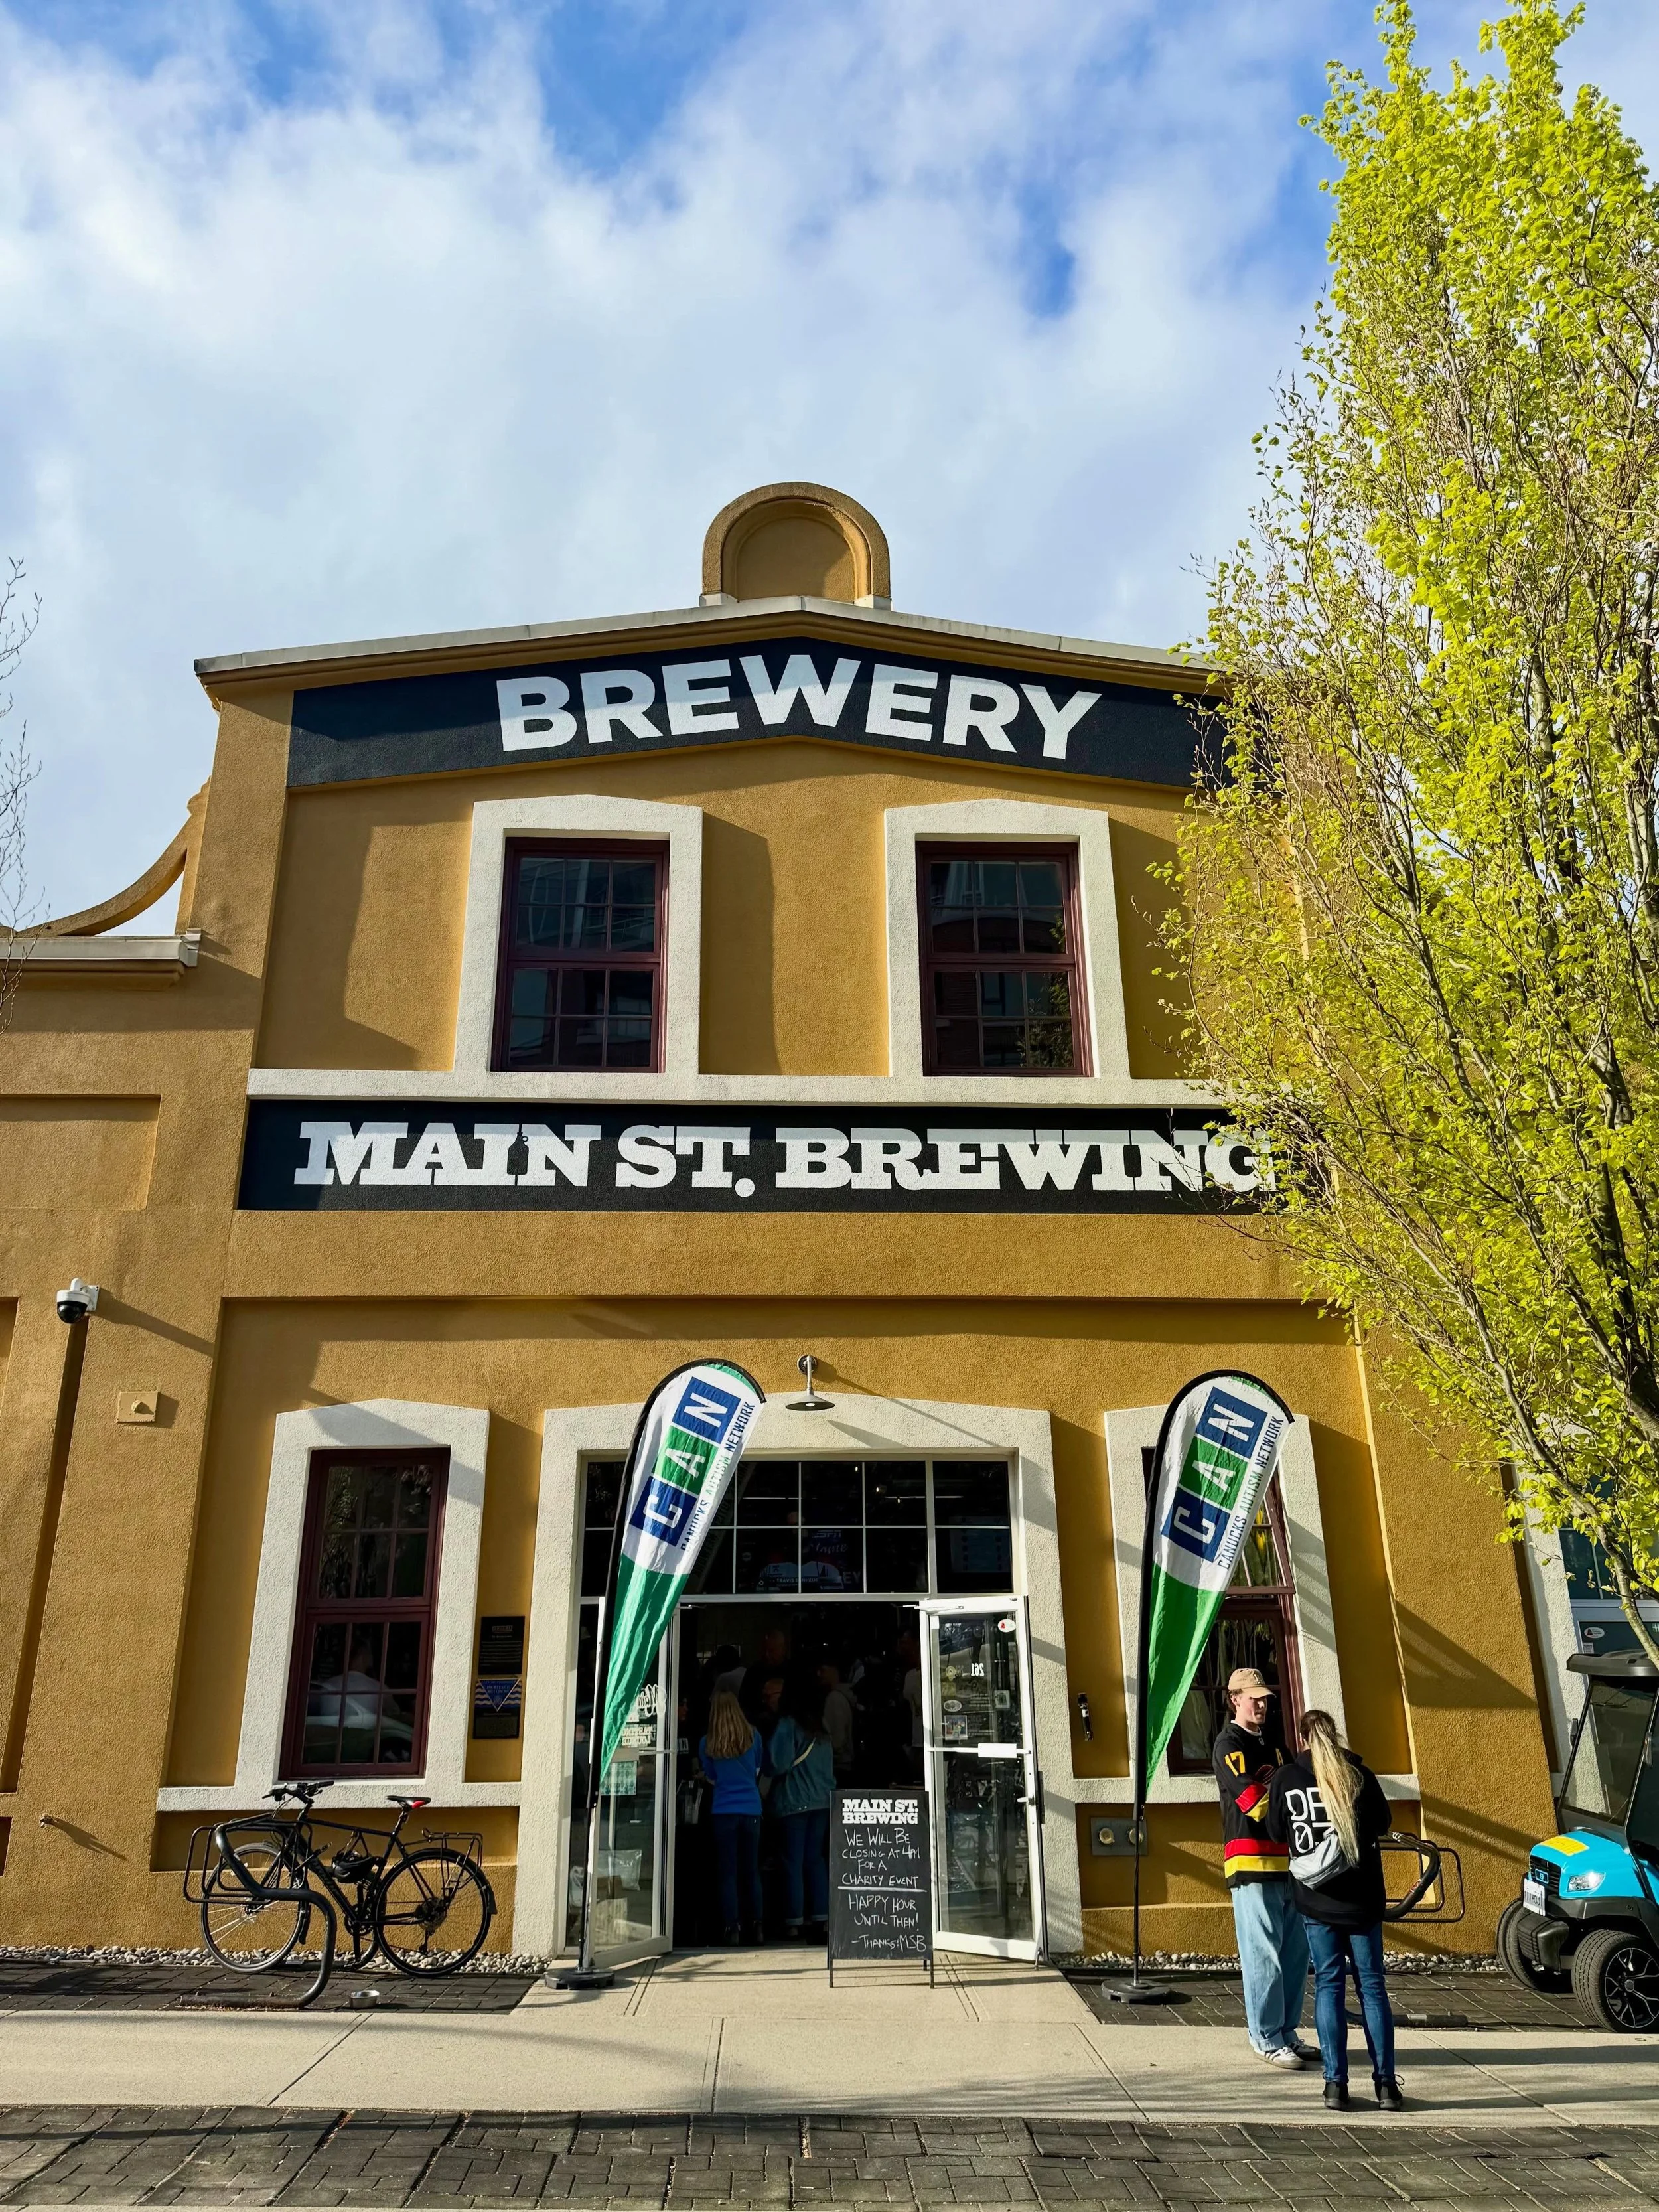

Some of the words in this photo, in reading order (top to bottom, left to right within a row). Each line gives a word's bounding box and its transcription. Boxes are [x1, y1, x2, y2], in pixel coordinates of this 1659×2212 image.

[496, 654, 1102, 760] BREWERY
[293, 1122, 601, 1186] MAIN
[615, 1124, 755, 1198] ST.
[775, 1128, 1277, 1192] BREWING
[724, 1402, 756, 1453] NETWORK
[1217, 1515, 1247, 1570] CANUCKS
[1239, 1471, 1264, 1514] AUTISM
[1254, 1416, 1284, 1469] NETWORK
[1224, 1751, 1246, 1777] 17
[842, 1799, 893, 1812] MAIN
[894, 1799, 919, 1812] ST.
[842, 1812, 918, 1824] BREWING
[842, 1848, 885, 1859] CLOSING
[888, 1849, 900, 1859] AT
[902, 1844, 920, 1860] 4PM
[877, 1859, 887, 1872] A
[842, 1873, 884, 1885] CHARITY
[889, 1875, 919, 1889] EVENT
[848, 1893, 889, 1914] HAPPY
[892, 1895, 917, 1913] HOUR
[854, 1913, 888, 1926] UNTIL
